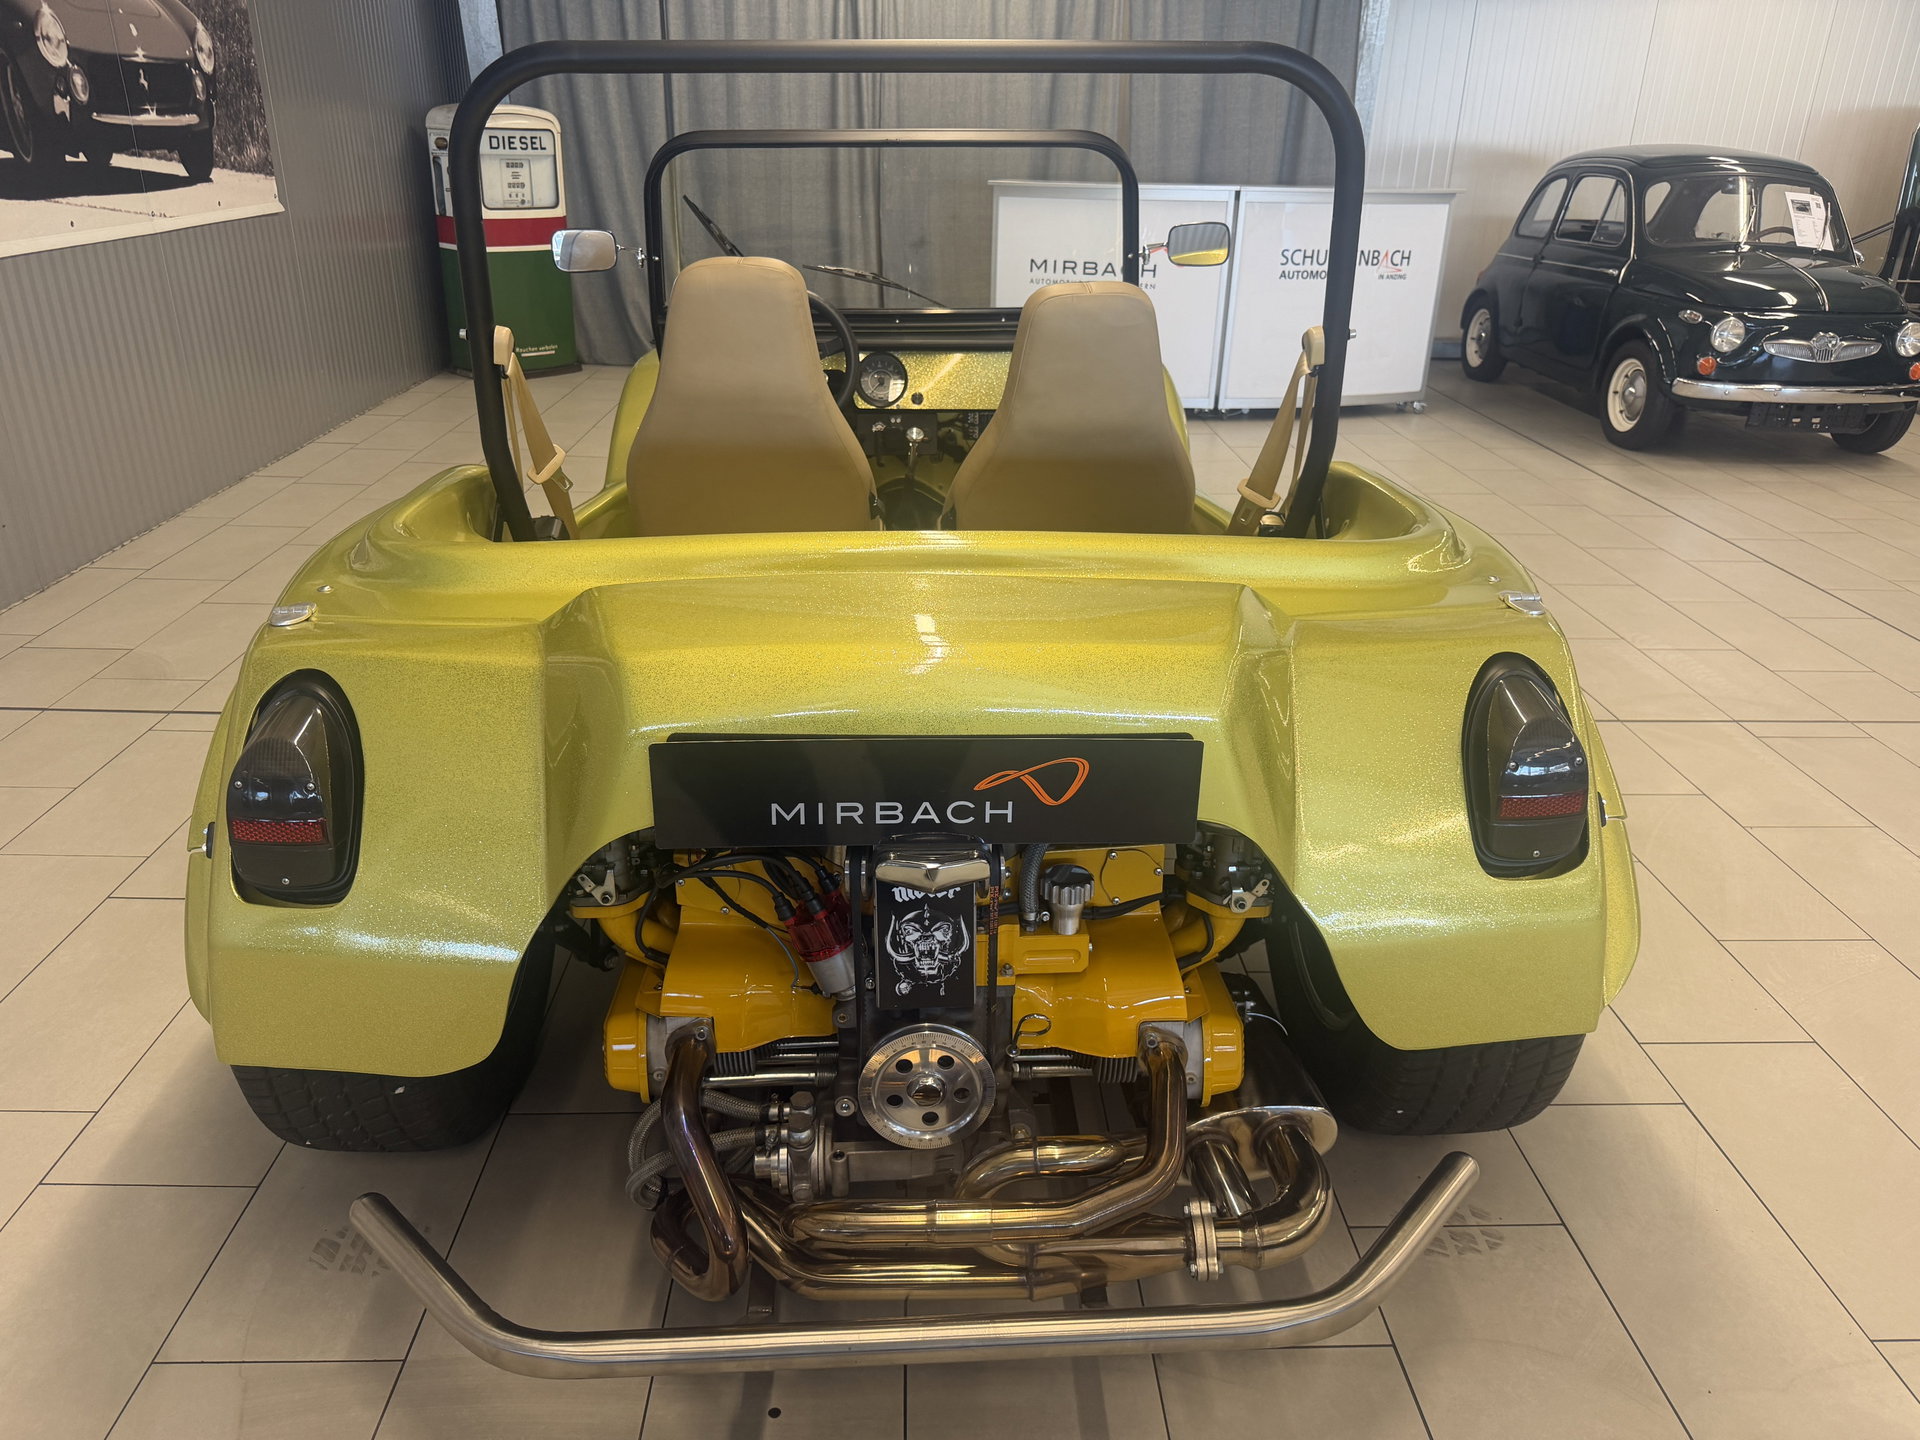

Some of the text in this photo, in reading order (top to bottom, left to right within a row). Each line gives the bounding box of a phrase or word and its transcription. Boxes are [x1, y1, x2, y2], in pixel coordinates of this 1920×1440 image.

[489, 135, 547, 151] DIESEL
[1029, 258, 1157, 278] MIRBAH
[771, 801, 1013, 825] MIRBACH
